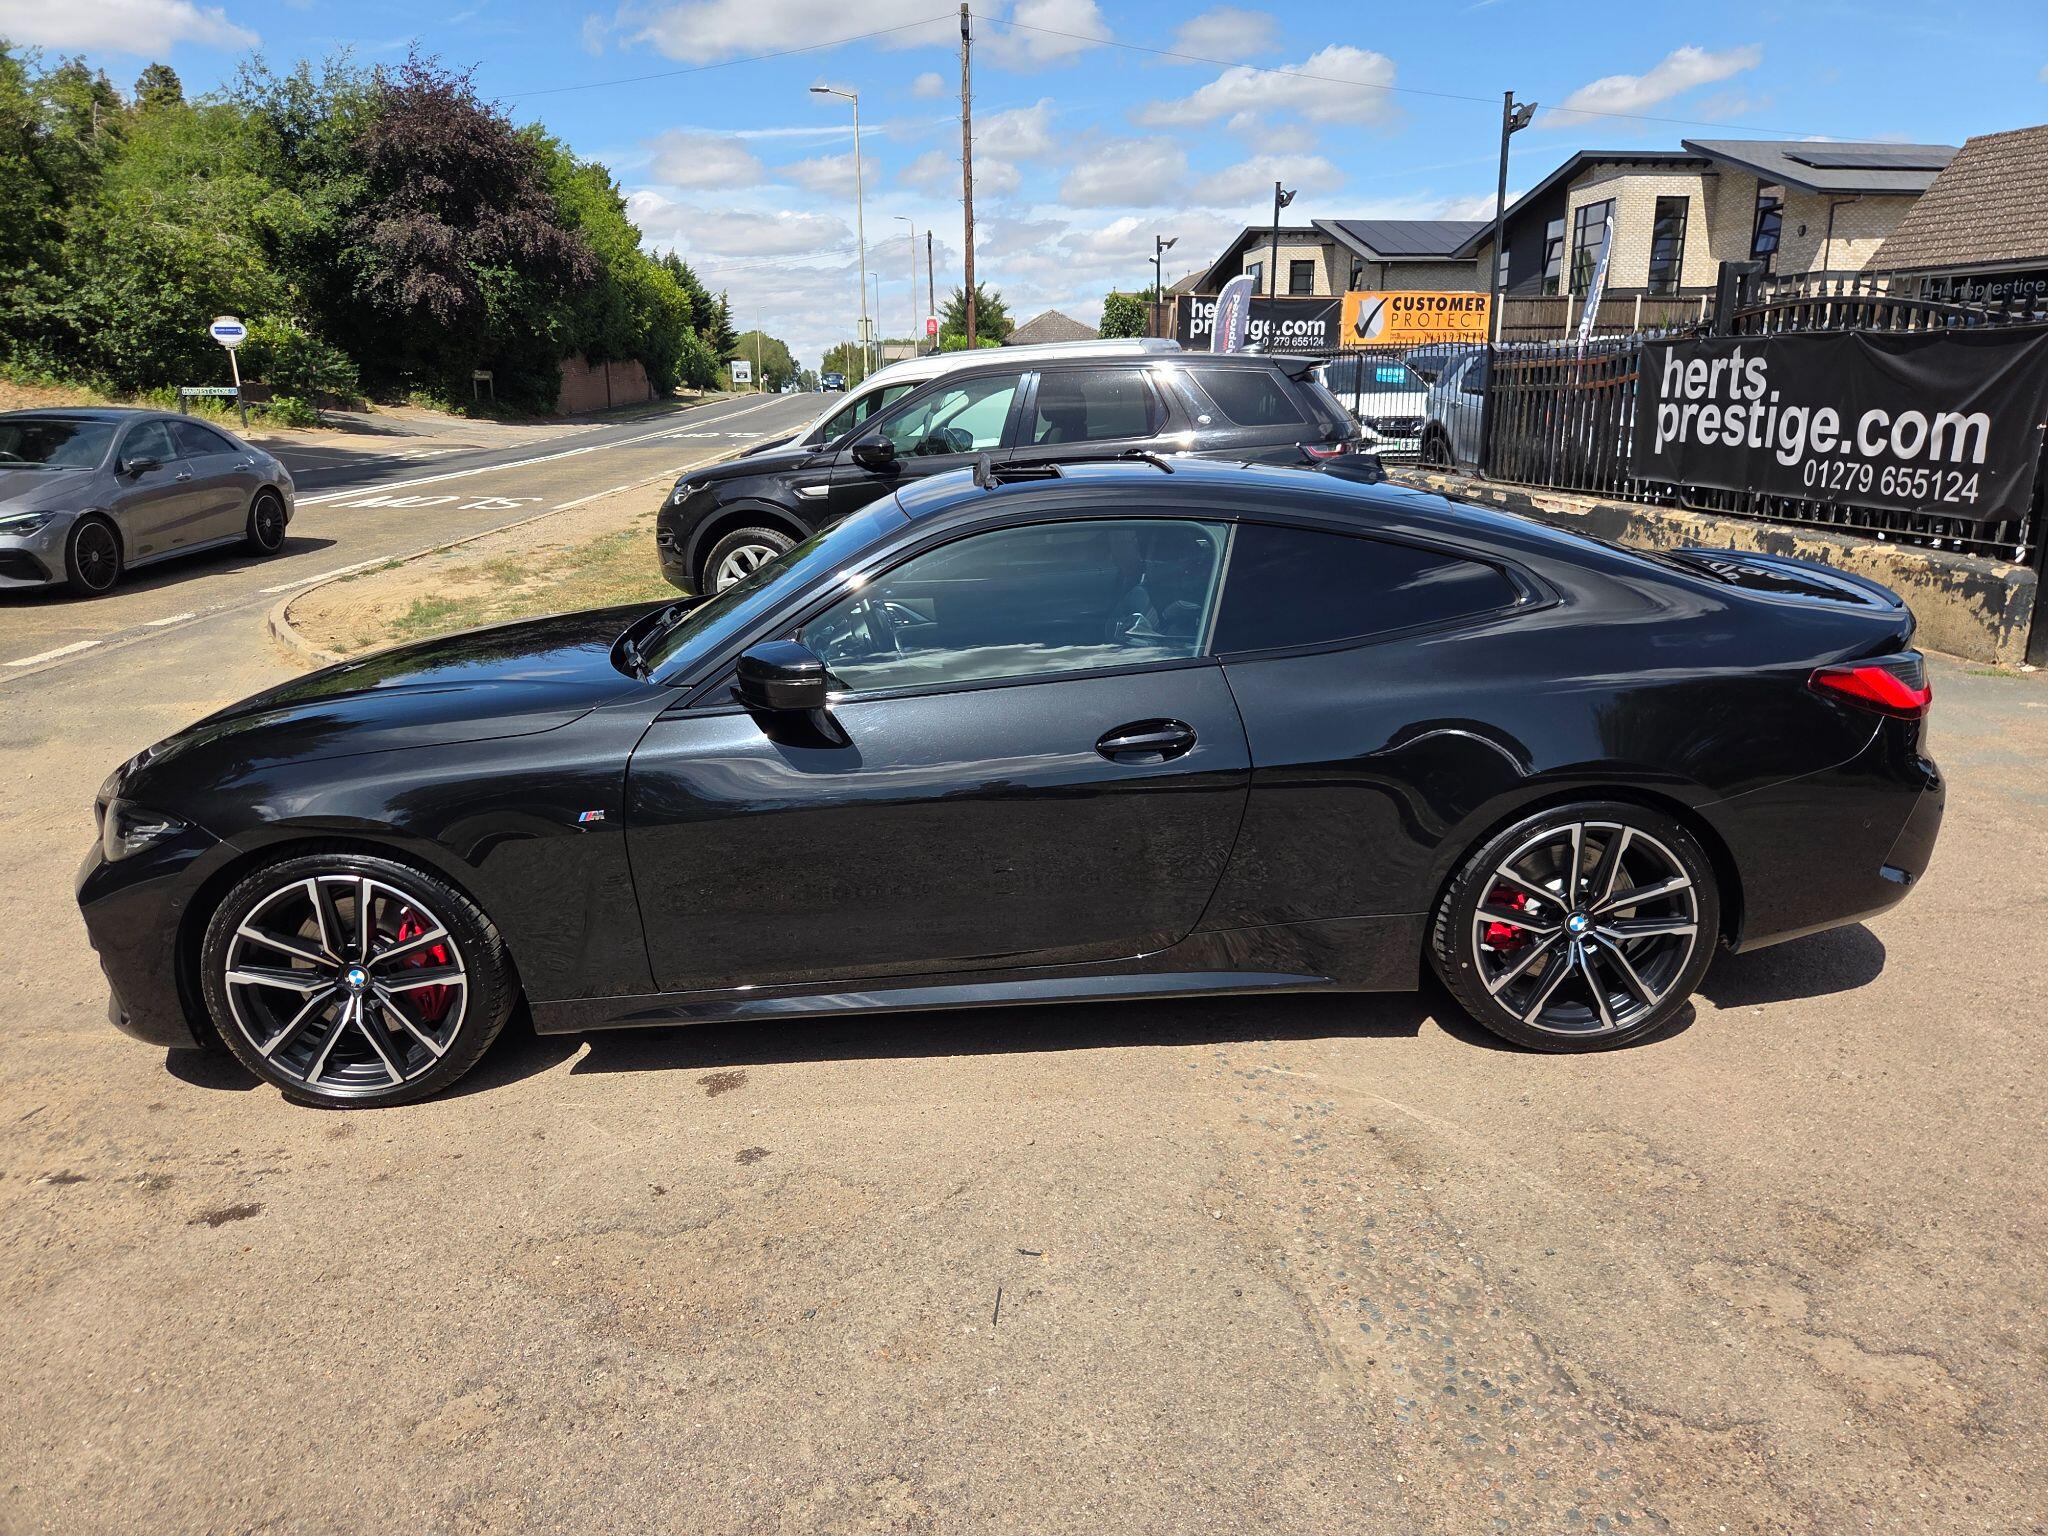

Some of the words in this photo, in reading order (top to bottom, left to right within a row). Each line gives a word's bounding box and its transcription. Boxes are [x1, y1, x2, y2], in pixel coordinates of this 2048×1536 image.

[1930, 278, 2046, 300] Hrtspestige
[1392, 297, 1486, 312] CUSTOMER
[1391, 312, 1485, 328] PROTECT
[1263, 336, 1290, 347] 0279
[1291, 336, 1324, 347] 655124
[1660, 345, 1780, 401] herts.
[1654, 391, 1990, 467] prestige.com
[1803, 459, 1873, 494] 01279
[1880, 465, 1980, 504] 655124
